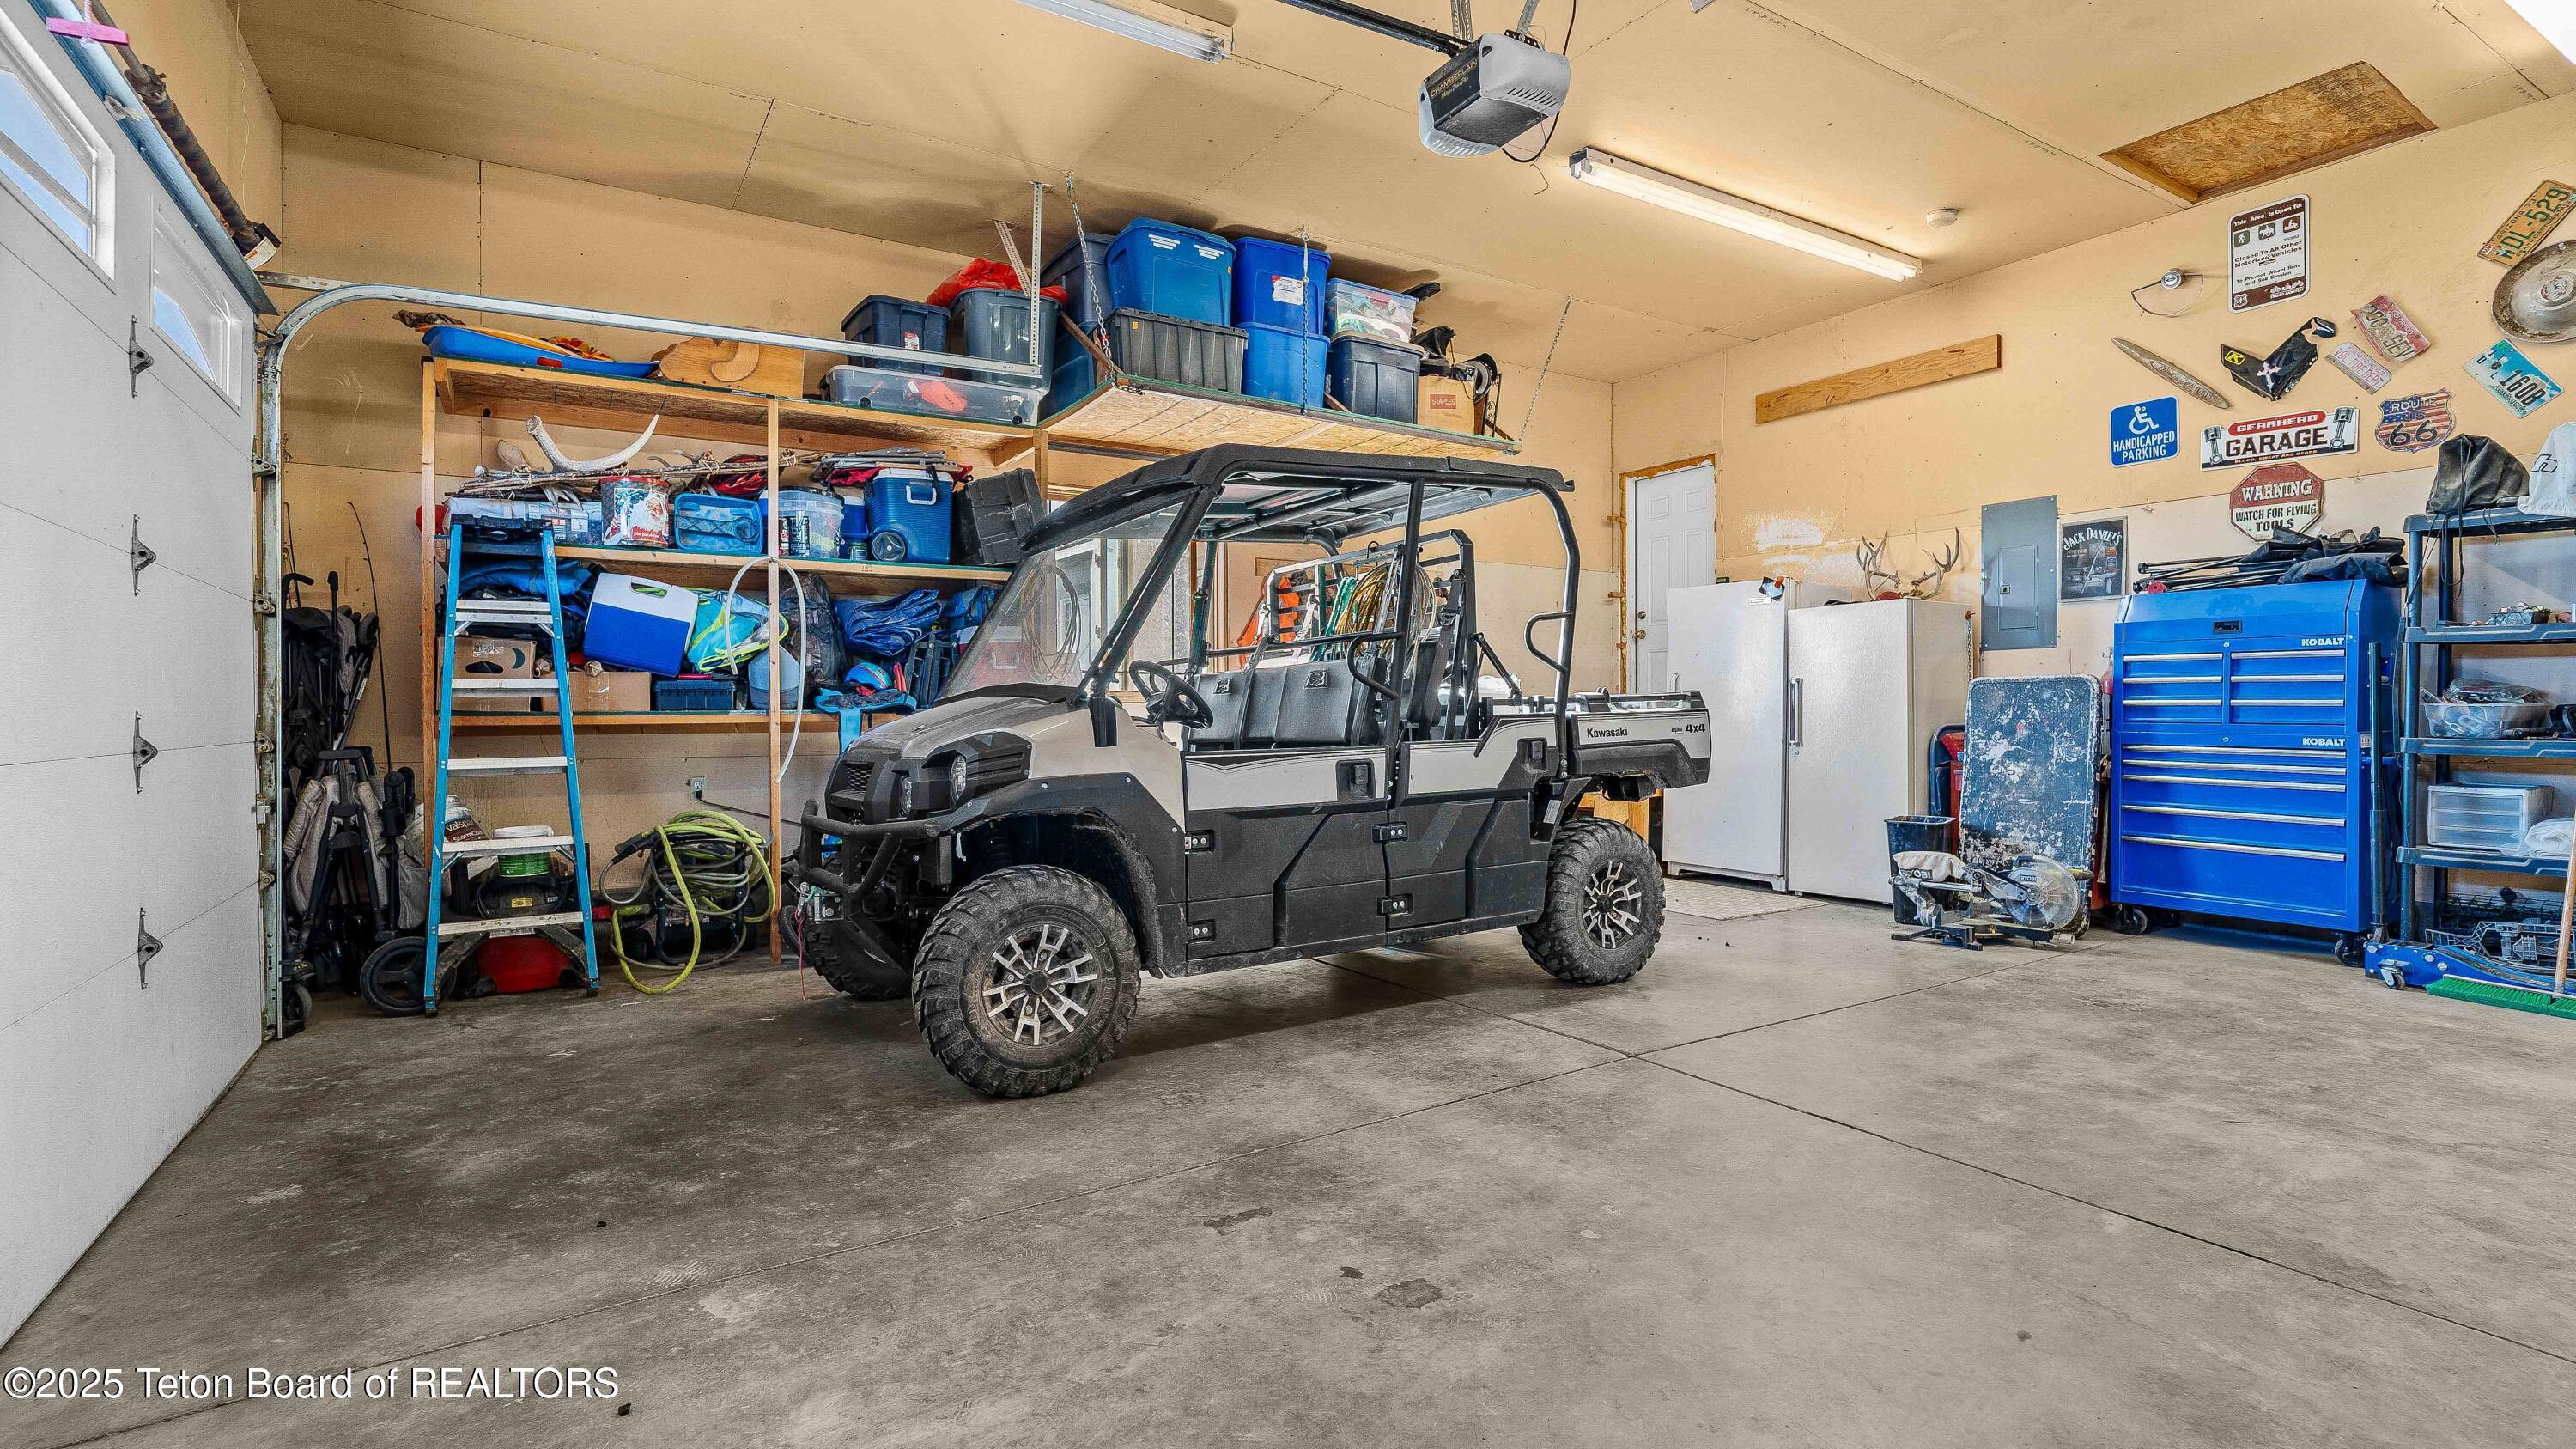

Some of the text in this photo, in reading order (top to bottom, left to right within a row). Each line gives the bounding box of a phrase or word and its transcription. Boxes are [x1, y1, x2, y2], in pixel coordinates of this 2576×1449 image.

[1431, 58, 1478, 97] CHAMBERLAIN
[2233, 218, 2246, 227] This
[2250, 213, 2265, 222] Area
[2496, 210, 2525, 240] ARIZONA
[2234, 251, 2259, 263] Closed
[2281, 240, 2302, 249] Other
[2234, 246, 2302, 268] Motorized Vehicles
[2245, 272, 2266, 281] Prevent
[2392, 309, 2414, 335] COLORADO
[2349, 358, 2367, 374] FIRE
[2391, 398, 2436, 411] ROUTE
[2236, 414, 2318, 433] GEARHEAD
[2390, 419, 2438, 446] 66
[2113, 430, 2175, 452] HANDICAPPED
[2225, 426, 2329, 458] GARAGE
[2122, 444, 2166, 462] PARKING
[2242, 479, 2313, 502] WARNING
[2235, 503, 2317, 521] WATCH FOR FLYING
[2063, 531, 2087, 550] JACK
[2301, 638, 2344, 647] KOBALT
[1587, 727, 1628, 739] Kawasaki
[1686, 723, 1706, 734] 4x4
[2302, 737, 2346, 746] KOBALT
